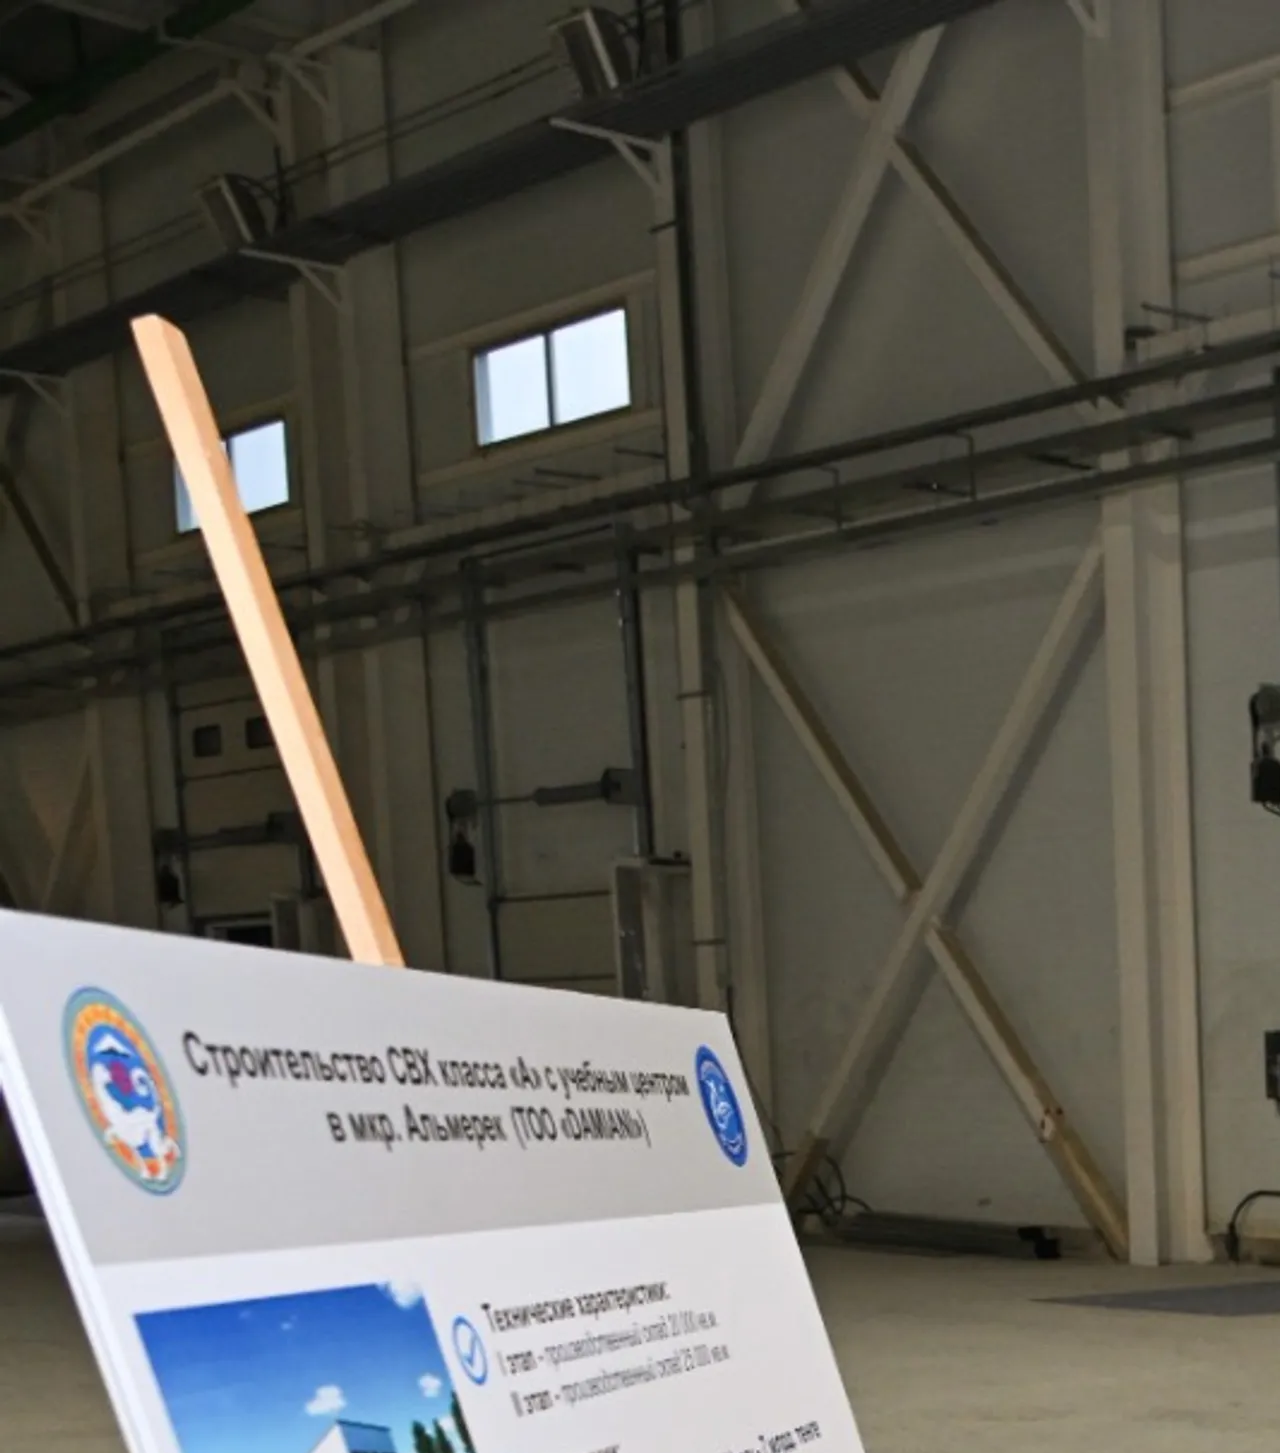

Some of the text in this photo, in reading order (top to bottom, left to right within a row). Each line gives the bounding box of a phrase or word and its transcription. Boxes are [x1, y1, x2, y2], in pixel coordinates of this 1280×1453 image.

[183, 1032, 387, 1088] Строительство
[388, 1047, 439, 1087] СВХ
[438, 1061, 508, 1090] класса
[558, 1062, 631, 1101] учебным
[630, 1073, 691, 1103] центром
[327, 1113, 348, 1144] в
[349, 1114, 403, 1152] мкр.
[404, 1105, 508, 1151] Альмерек
[511, 1107, 559, 1149] (ТОО
[481, 1299, 577, 1333] Технические
